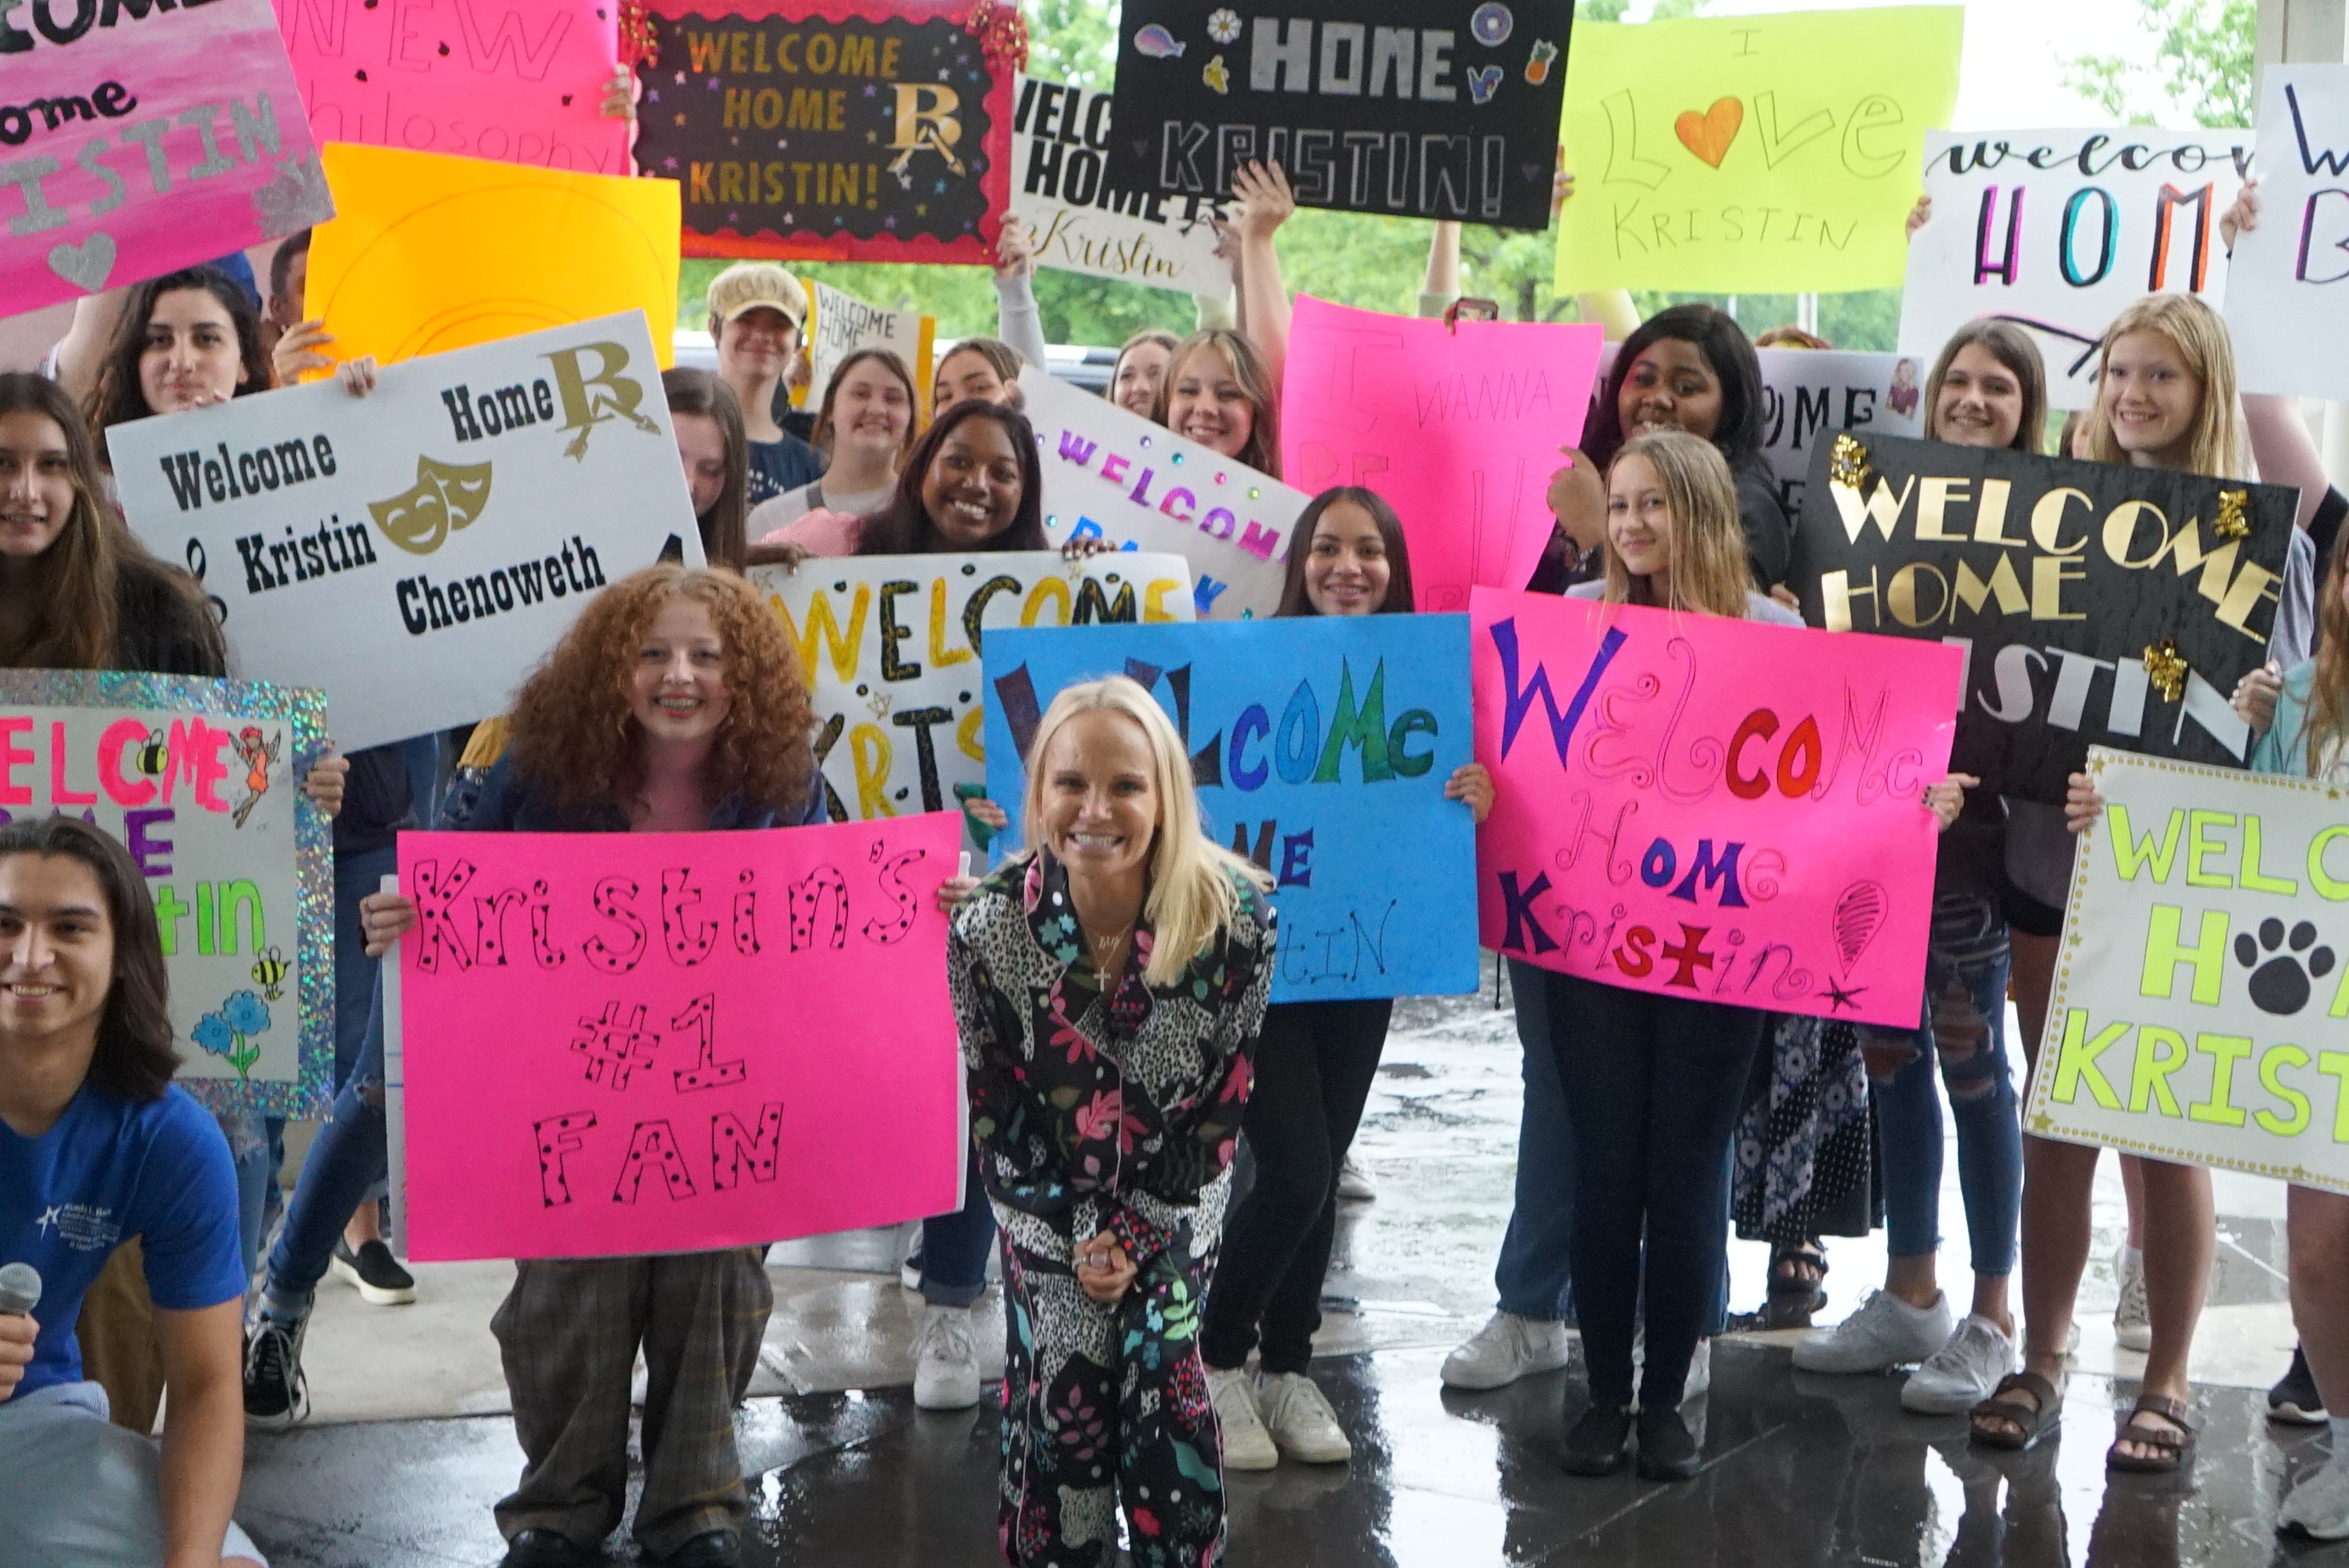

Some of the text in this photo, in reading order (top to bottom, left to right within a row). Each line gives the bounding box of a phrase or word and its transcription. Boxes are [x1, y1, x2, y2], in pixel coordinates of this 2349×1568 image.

[688, 31, 903, 78] WELCOME
[1249, 16, 1457, 102] HOME
[1730, 29, 1762, 57] I
[723, 87, 848, 131] HOME
[689, 160, 878, 210] KRISTIN!
[1613, 199, 1858, 260] KRISTIN
[161, 431, 337, 512] Welcome
[441, 377, 555, 442] Home
[1057, 429, 1287, 565] WELCOM
[235, 518, 377, 594] Kristin
[395, 534, 606, 637] Chenoweth
[1821, 550, 2088, 631] HOME
[1830, 474, 2285, 644] WELCOME
[570, 992, 747, 1094] #1
[534, 1101, 784, 1209] FAN
